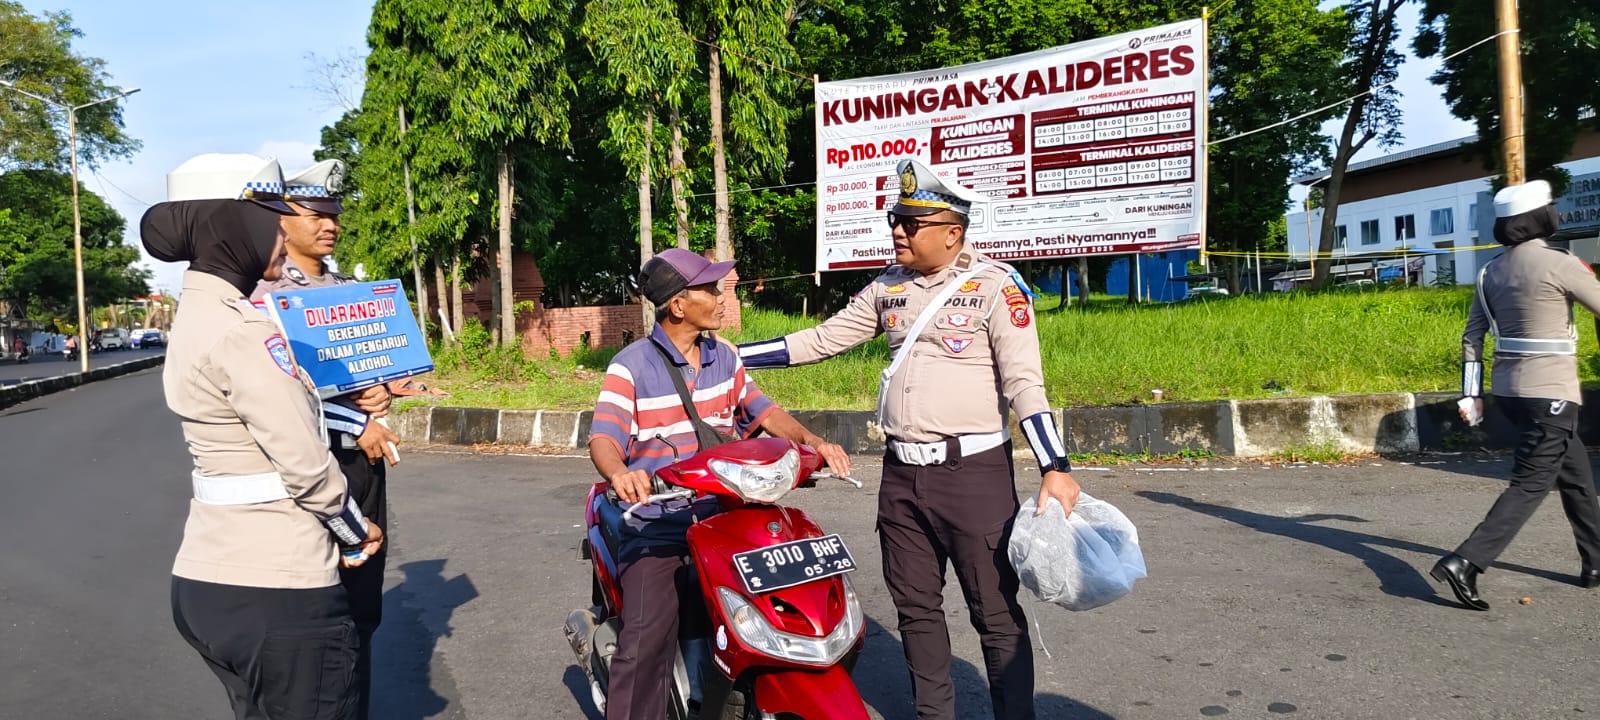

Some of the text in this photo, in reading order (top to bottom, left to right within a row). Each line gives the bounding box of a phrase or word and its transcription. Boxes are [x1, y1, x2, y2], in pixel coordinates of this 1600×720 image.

[823, 45, 1195, 126] KUNINGAN KALIDERES
[856, 80, 907, 94] TERBARU
[912, 72, 959, 86] PRIMAJASA
[1088, 87, 1149, 100] PEMBERANGKATAN
[1077, 94, 1193, 117] TERMINAL KUNINGAN
[1161, 111, 1188, 119] 10:00
[939, 117, 1014, 140] KUNINGAN
[1130, 126, 1154, 134] 17:00
[826, 148, 849, 169] Rp
[850, 137, 928, 162] 110.000,-
[941, 141, 1013, 162] KALIDERES
[1080, 141, 1193, 162] TERMINAL KALIDERES
[1163, 158, 1188, 167] 10:00
[1131, 172, 1156, 181] 17:00
[826, 181, 873, 195] Rp 30.000,-
[826, 201, 874, 214] Rp 100.000,-
[1125, 202, 1192, 214] DARI KUNINGAN
[841, 228, 872, 236] KALIDERES
[852, 246, 876, 258] Pasti
[1036, 234, 1065, 246] Pasti
[1067, 228, 1157, 245] Nyamannya!!!
[989, 249, 1030, 259] TANGGAL
[1046, 246, 1087, 255] OKTOBER
[305, 298, 396, 328] DILARANG!!!
[944, 297, 984, 309] POLRI
[327, 321, 387, 342] BEKENDARA
[317, 334, 409, 362] DALAM PENGARUH
[348, 355, 394, 375] ALKOHOL
[737, 537, 840, 574] E 3010 BHF
